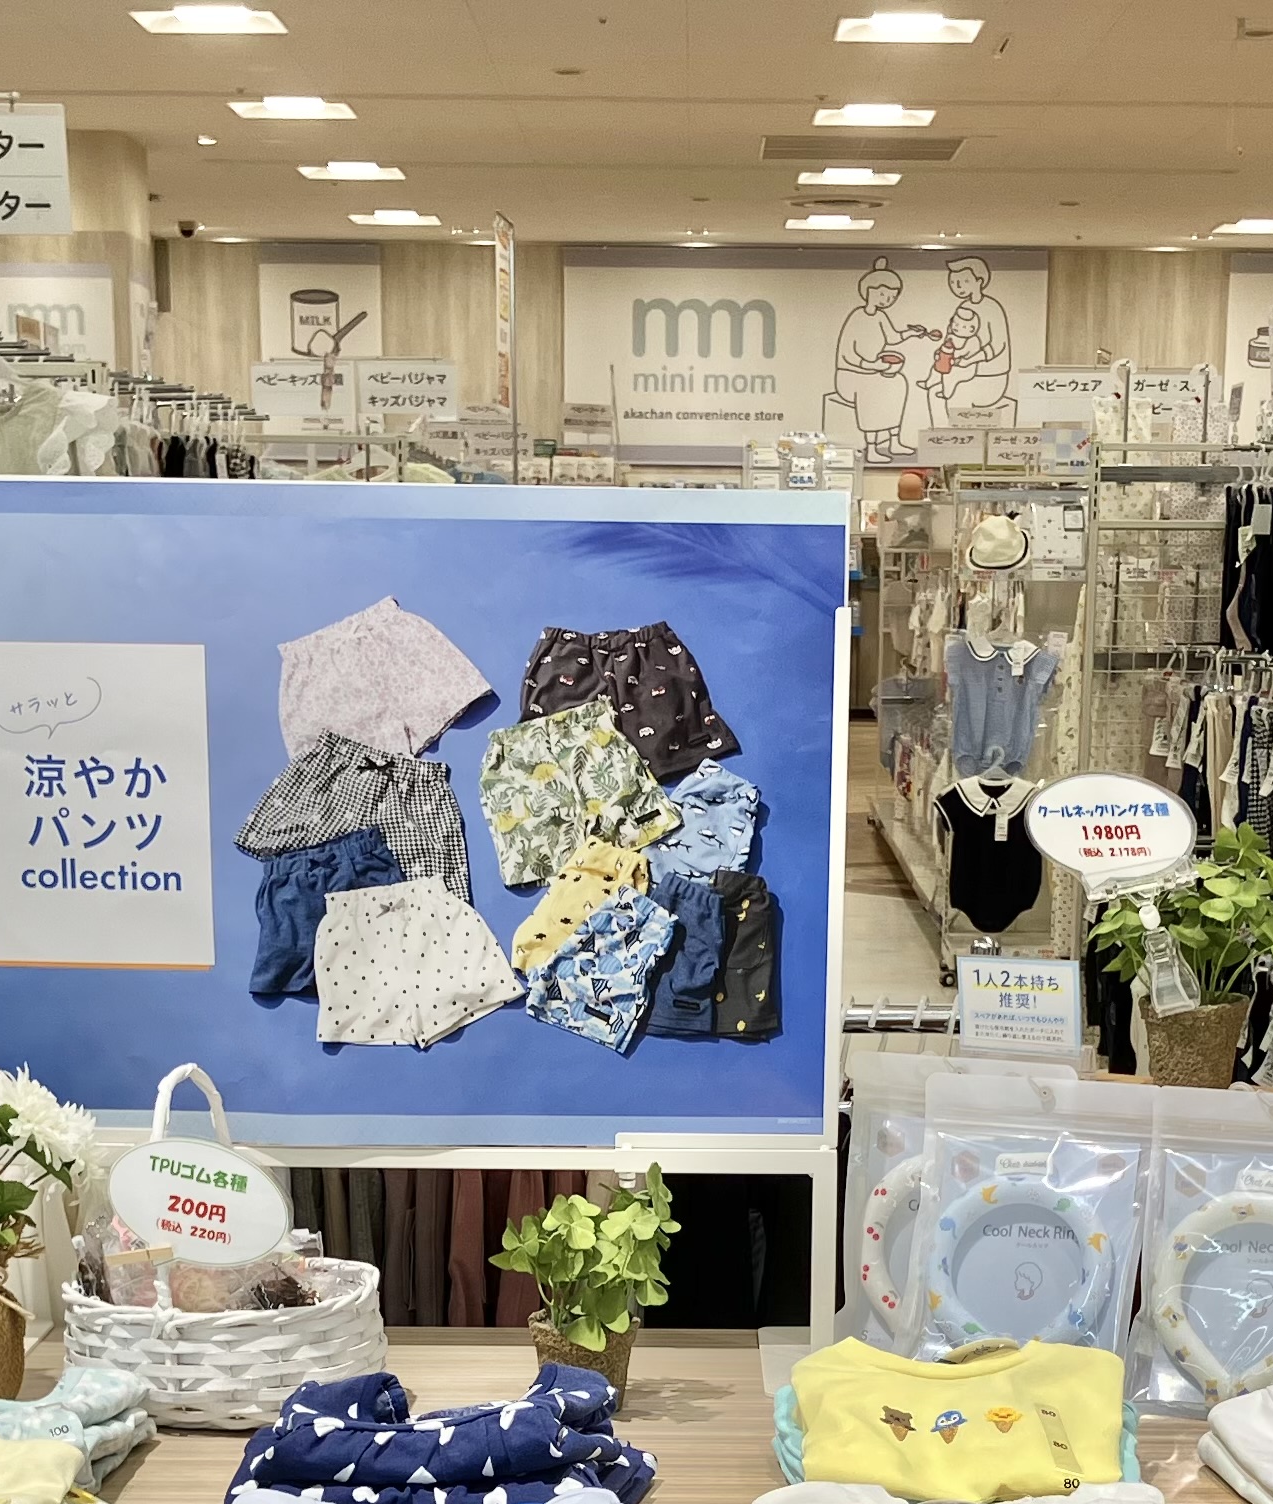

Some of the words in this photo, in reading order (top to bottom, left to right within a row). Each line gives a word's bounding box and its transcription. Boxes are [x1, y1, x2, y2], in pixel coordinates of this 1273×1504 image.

[299, 315, 332, 326] MILK
[368, 372, 447, 385] ベビーパジャマ
[633, 365, 694, 393] mini
[703, 373, 776, 394] mom
[1033, 380, 1102, 392] ベビーウェア
[368, 394, 447, 408] キッズパジャマ
[623, 408, 673, 420] akachan
[676, 409, 751, 421] convenience
[754, 410, 784, 421] store
[927, 435, 975, 445] ベビーウェア
[993, 435, 1042, 445] ガーゼ・スタ
[10, 692, 78, 715] サラッと
[24, 754, 168, 799] 涼やか
[1038, 802, 1170, 817] クールネックリング各種
[28, 807, 162, 851] パンツ
[21, 857, 183, 891] collection
[973, 969, 1059, 991] 1人2本持ち
[999, 992, 1037, 1009] 推奨!
[149, 1155, 249, 1194] TPUゴム各種
[168, 1195, 227, 1223] 200円
[982, 1224, 1013, 1238] Cool
[1018, 1225, 1049, 1239] Neck
[1053, 1226, 1078, 1240] Rin
[49, 1425, 69, 1437] 100
[1063, 1478, 1081, 1489] 80
